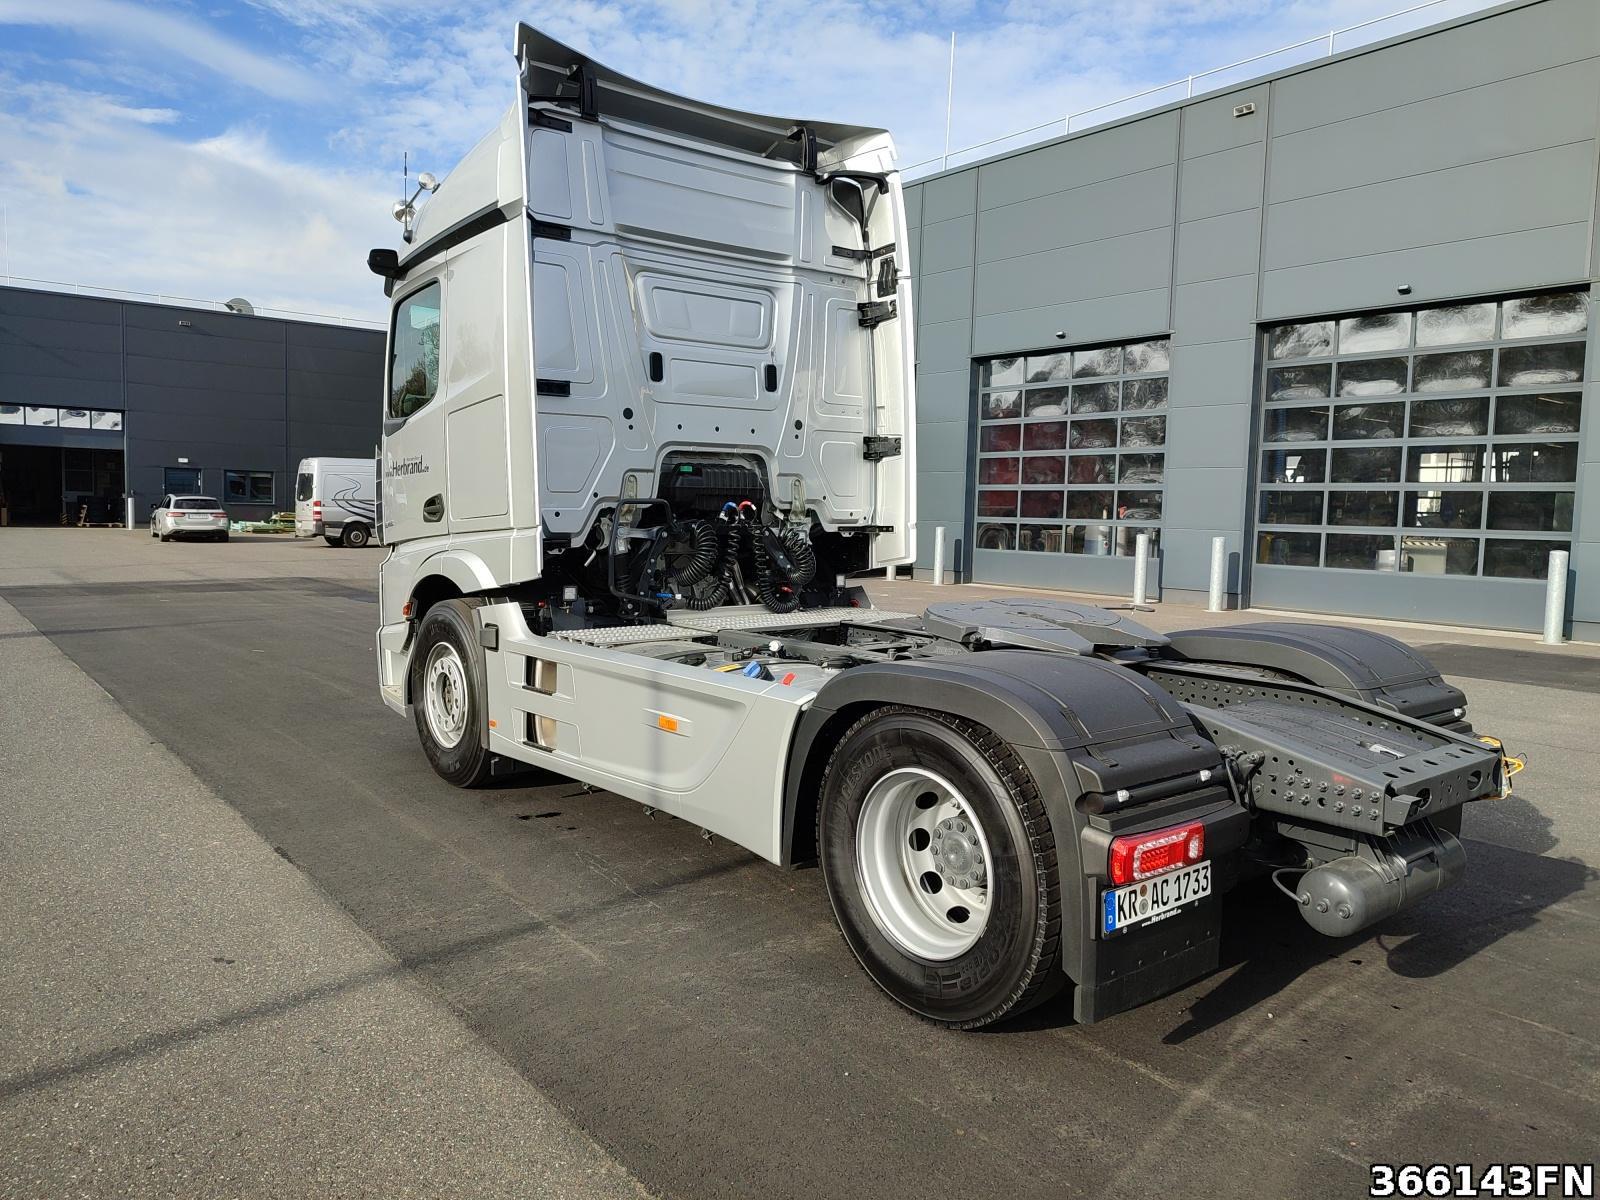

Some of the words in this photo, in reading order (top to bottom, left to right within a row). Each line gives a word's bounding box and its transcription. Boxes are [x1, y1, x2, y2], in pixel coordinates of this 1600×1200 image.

[1117, 889, 1138, 922] KR
[1151, 879, 1170, 911] AC
[1174, 865, 1209, 902] 1733
